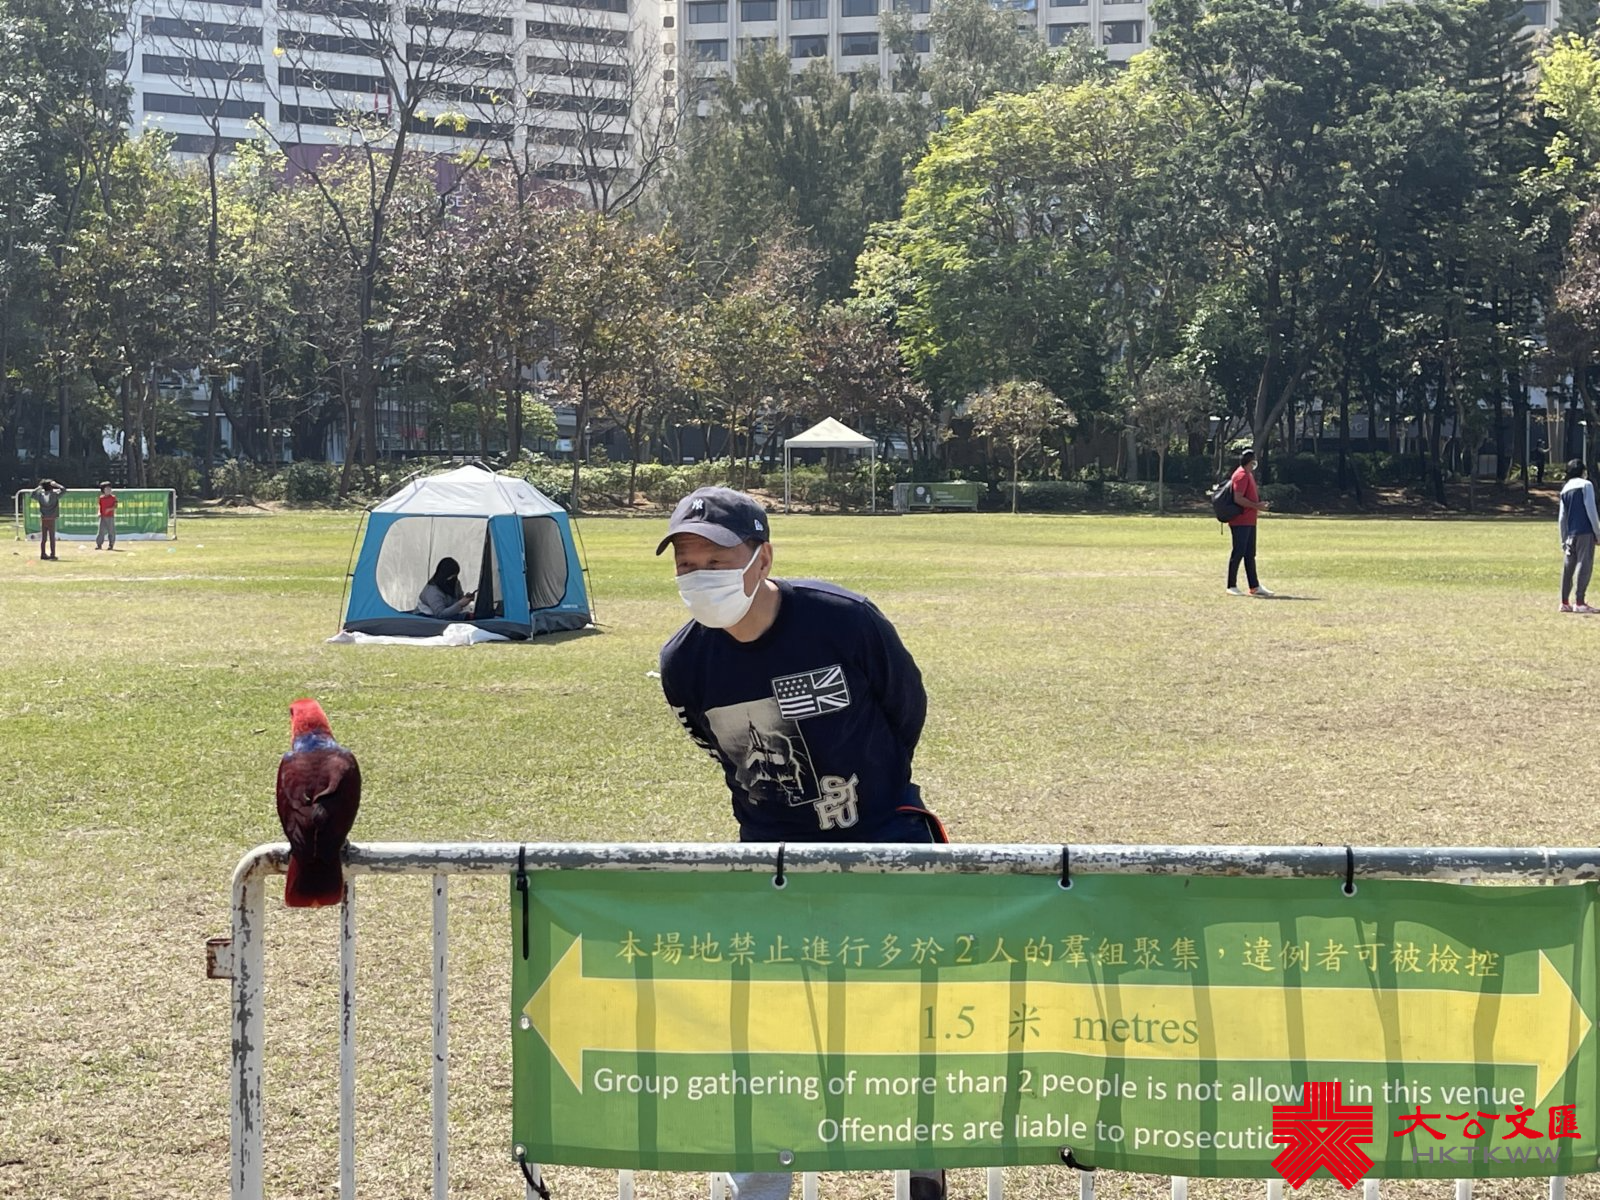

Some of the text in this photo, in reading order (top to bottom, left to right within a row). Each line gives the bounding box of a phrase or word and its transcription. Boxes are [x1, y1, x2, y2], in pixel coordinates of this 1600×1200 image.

[923, 1005, 975, 1041] 1.5
[1008, 1003, 1042, 1043] 米
[1073, 1013, 1199, 1045] metres
[593, 1067, 1526, 1106] Group gathering of more than 2 people is not allow in this venue
[817, 1117, 954, 1144] Offenders
[962, 1120, 1004, 1142] are
[1014, 1115, 1087, 1140] liable
[1096, 1119, 1125, 1143] to
